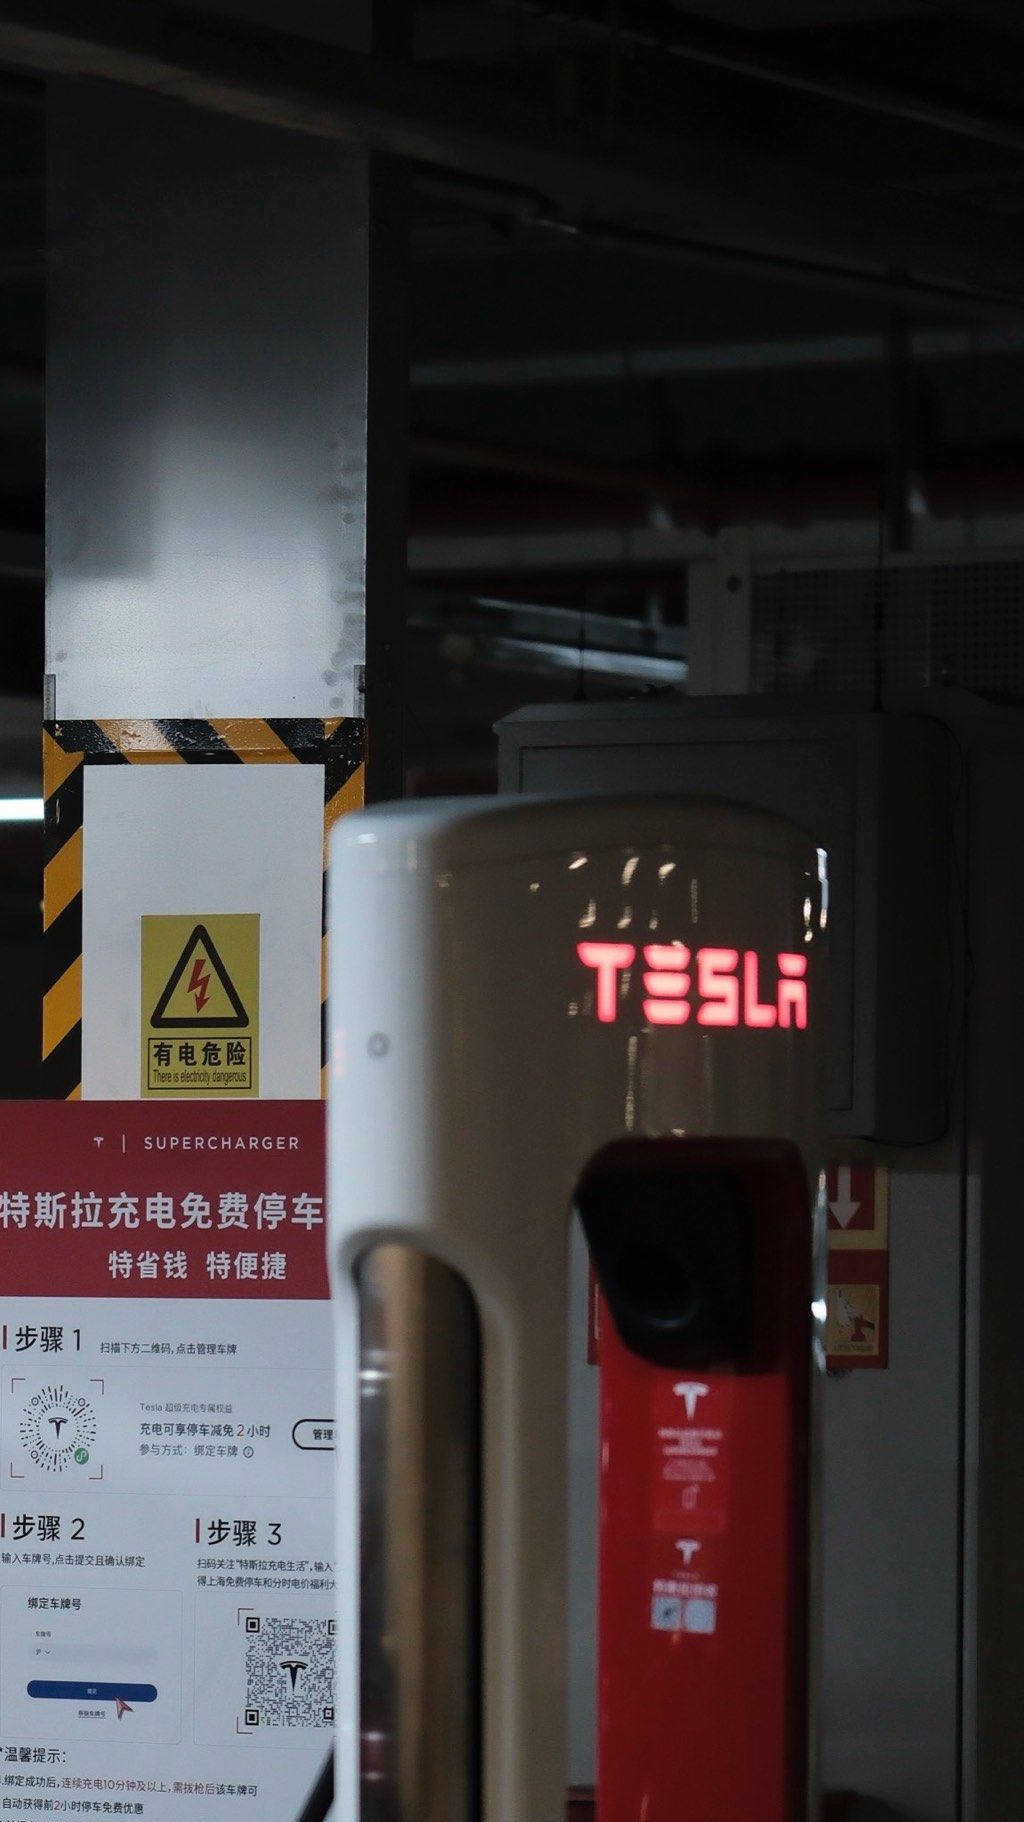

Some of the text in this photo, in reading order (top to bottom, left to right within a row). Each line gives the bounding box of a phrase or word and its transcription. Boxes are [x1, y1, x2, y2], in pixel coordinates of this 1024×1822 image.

[576, 942, 807, 1029] TESLA
[153, 1041, 246, 1067] 有电危险
[153, 1069, 172, 1083] There
[173, 1070, 179, 1083] is
[212, 1069, 247, 1086] dangerous
[144, 1136, 299, 1150] SUPERCHARGER
[108, 1250, 287, 1281] 特省钱 特便捷
[14, 1325, 81, 1353] 步骤 1
[139, 1402, 163, 1412] Tesla
[140, 1422, 271, 1438] 充电可享停车减免 2 小时
[312, 1428, 335, 1441] 管理
[12, 1513, 86, 1542] 步骤 2
[207, 1518, 282, 1548] 步骤 3
[27, 1596, 82, 1611] 绑定车牌号
[2, 1797, 144, 1815] 自动获得前2小时停车免费优惠
